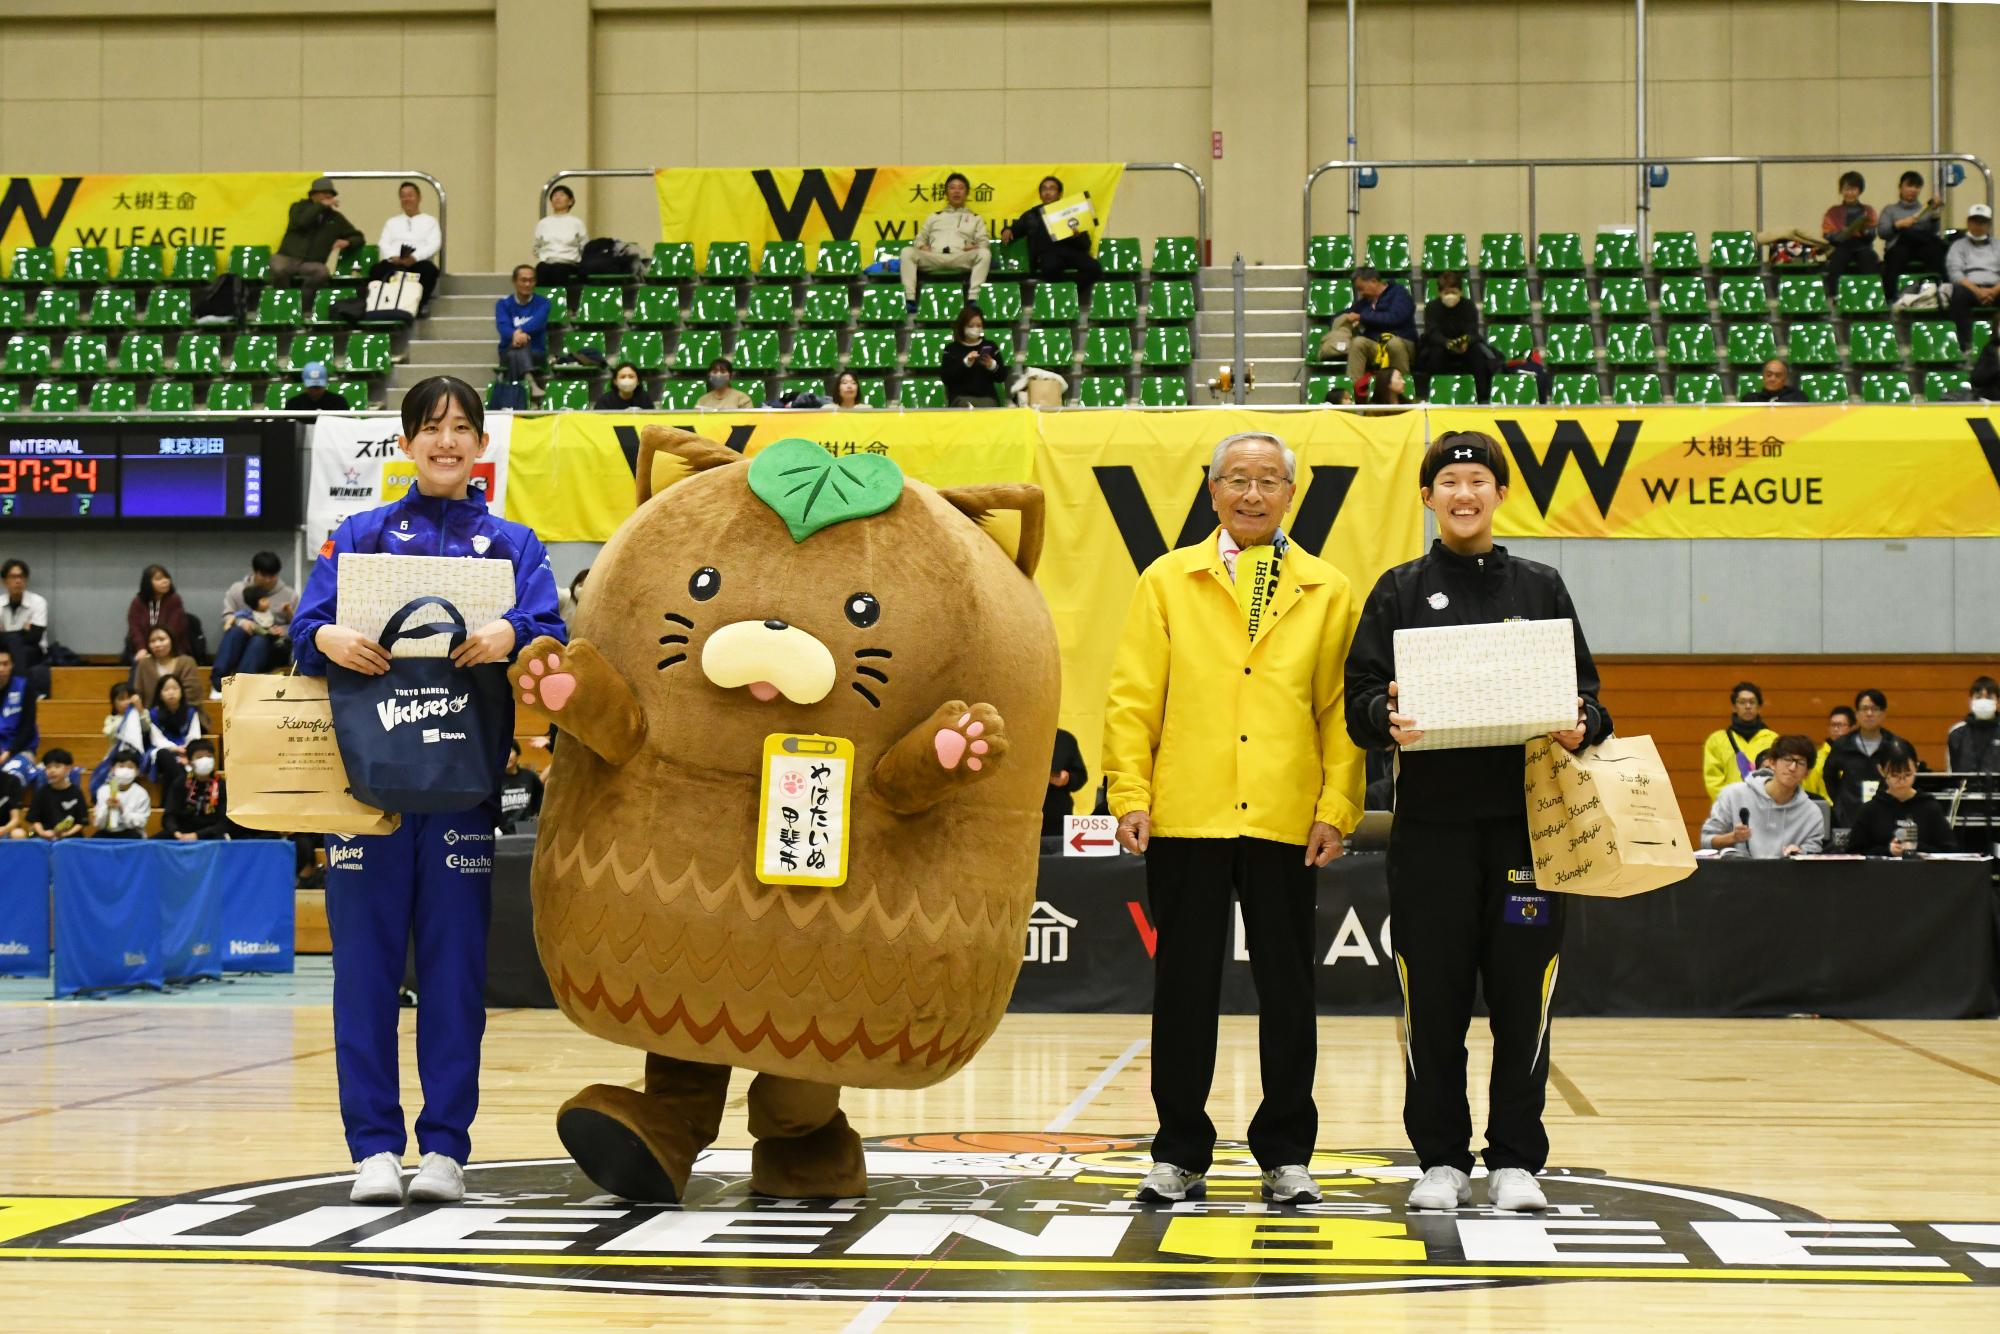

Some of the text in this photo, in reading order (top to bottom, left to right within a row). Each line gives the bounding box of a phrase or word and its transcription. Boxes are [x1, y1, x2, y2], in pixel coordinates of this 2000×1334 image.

[112, 191, 198, 211] 大樹生命
[752, 169, 877, 242] W
[114, 226, 227, 250] LEAGUE
[9, 438, 84, 454] INTERVAL
[159, 437, 224, 454] 東京羽田
[1682, 435, 1786, 458] 大樹生命
[0, 459, 97, 493] 37:24
[1495, 420, 1644, 520] W
[1641, 477, 1824, 504] W LEAGUE
[399, 520, 409, 531] 6
[394, 687, 449, 697] TOKYO HANEDA
[376, 698, 449, 732] Vickies
[440, 732, 467, 740] EBARA
[806, 762, 832, 870] やはたいぬ
[1071, 818, 1112, 831] POSS.
[329, 844, 364, 868] Vickies
[1554, 859, 1593, 886] Kurofuji
[229, 940, 280, 955] Nittaku
[0, 1197, 2000, 1269] UEENBEE
